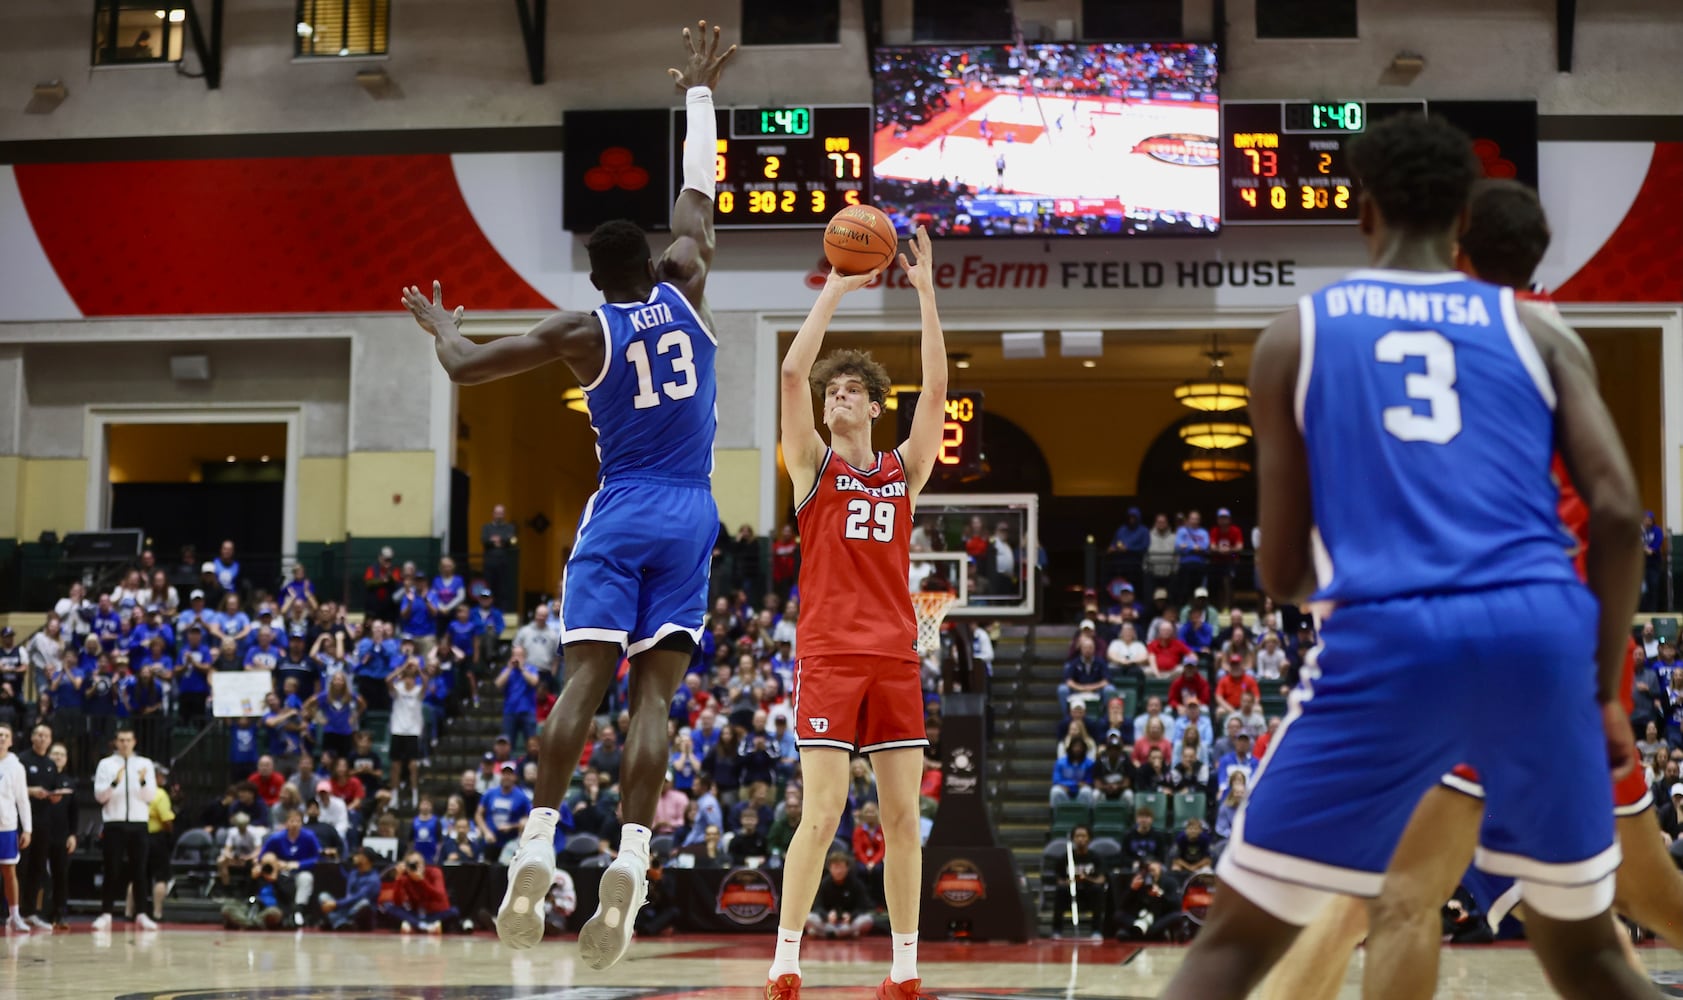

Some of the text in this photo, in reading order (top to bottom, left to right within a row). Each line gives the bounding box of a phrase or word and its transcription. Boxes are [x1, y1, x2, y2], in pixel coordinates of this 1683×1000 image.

[761, 108, 809, 134] 1:40
[1313, 102, 1361, 130] 1:40
[764, 156, 780, 178] 2
[827, 153, 861, 178] 77
[1244, 149, 1277, 177] 73
[1318, 153, 1332, 173] 2
[718, 191, 733, 213] 0
[749, 190, 796, 213] 30 2
[812, 190, 826, 213] 3
[1241, 188, 1256, 208] 4
[1270, 186, 1286, 209] 0
[1301, 185, 1349, 209] 30 2
[1060, 261, 1163, 288] FIELD
[1174, 260, 1296, 288] HOUSE
[629, 302, 673, 332] KEITA
[1326, 285, 1490, 327] DYBANTSA
[626, 329, 698, 410] 13
[1375, 330, 1462, 445] 3
[938, 422, 963, 464] 2
[845, 498, 896, 543] 29
